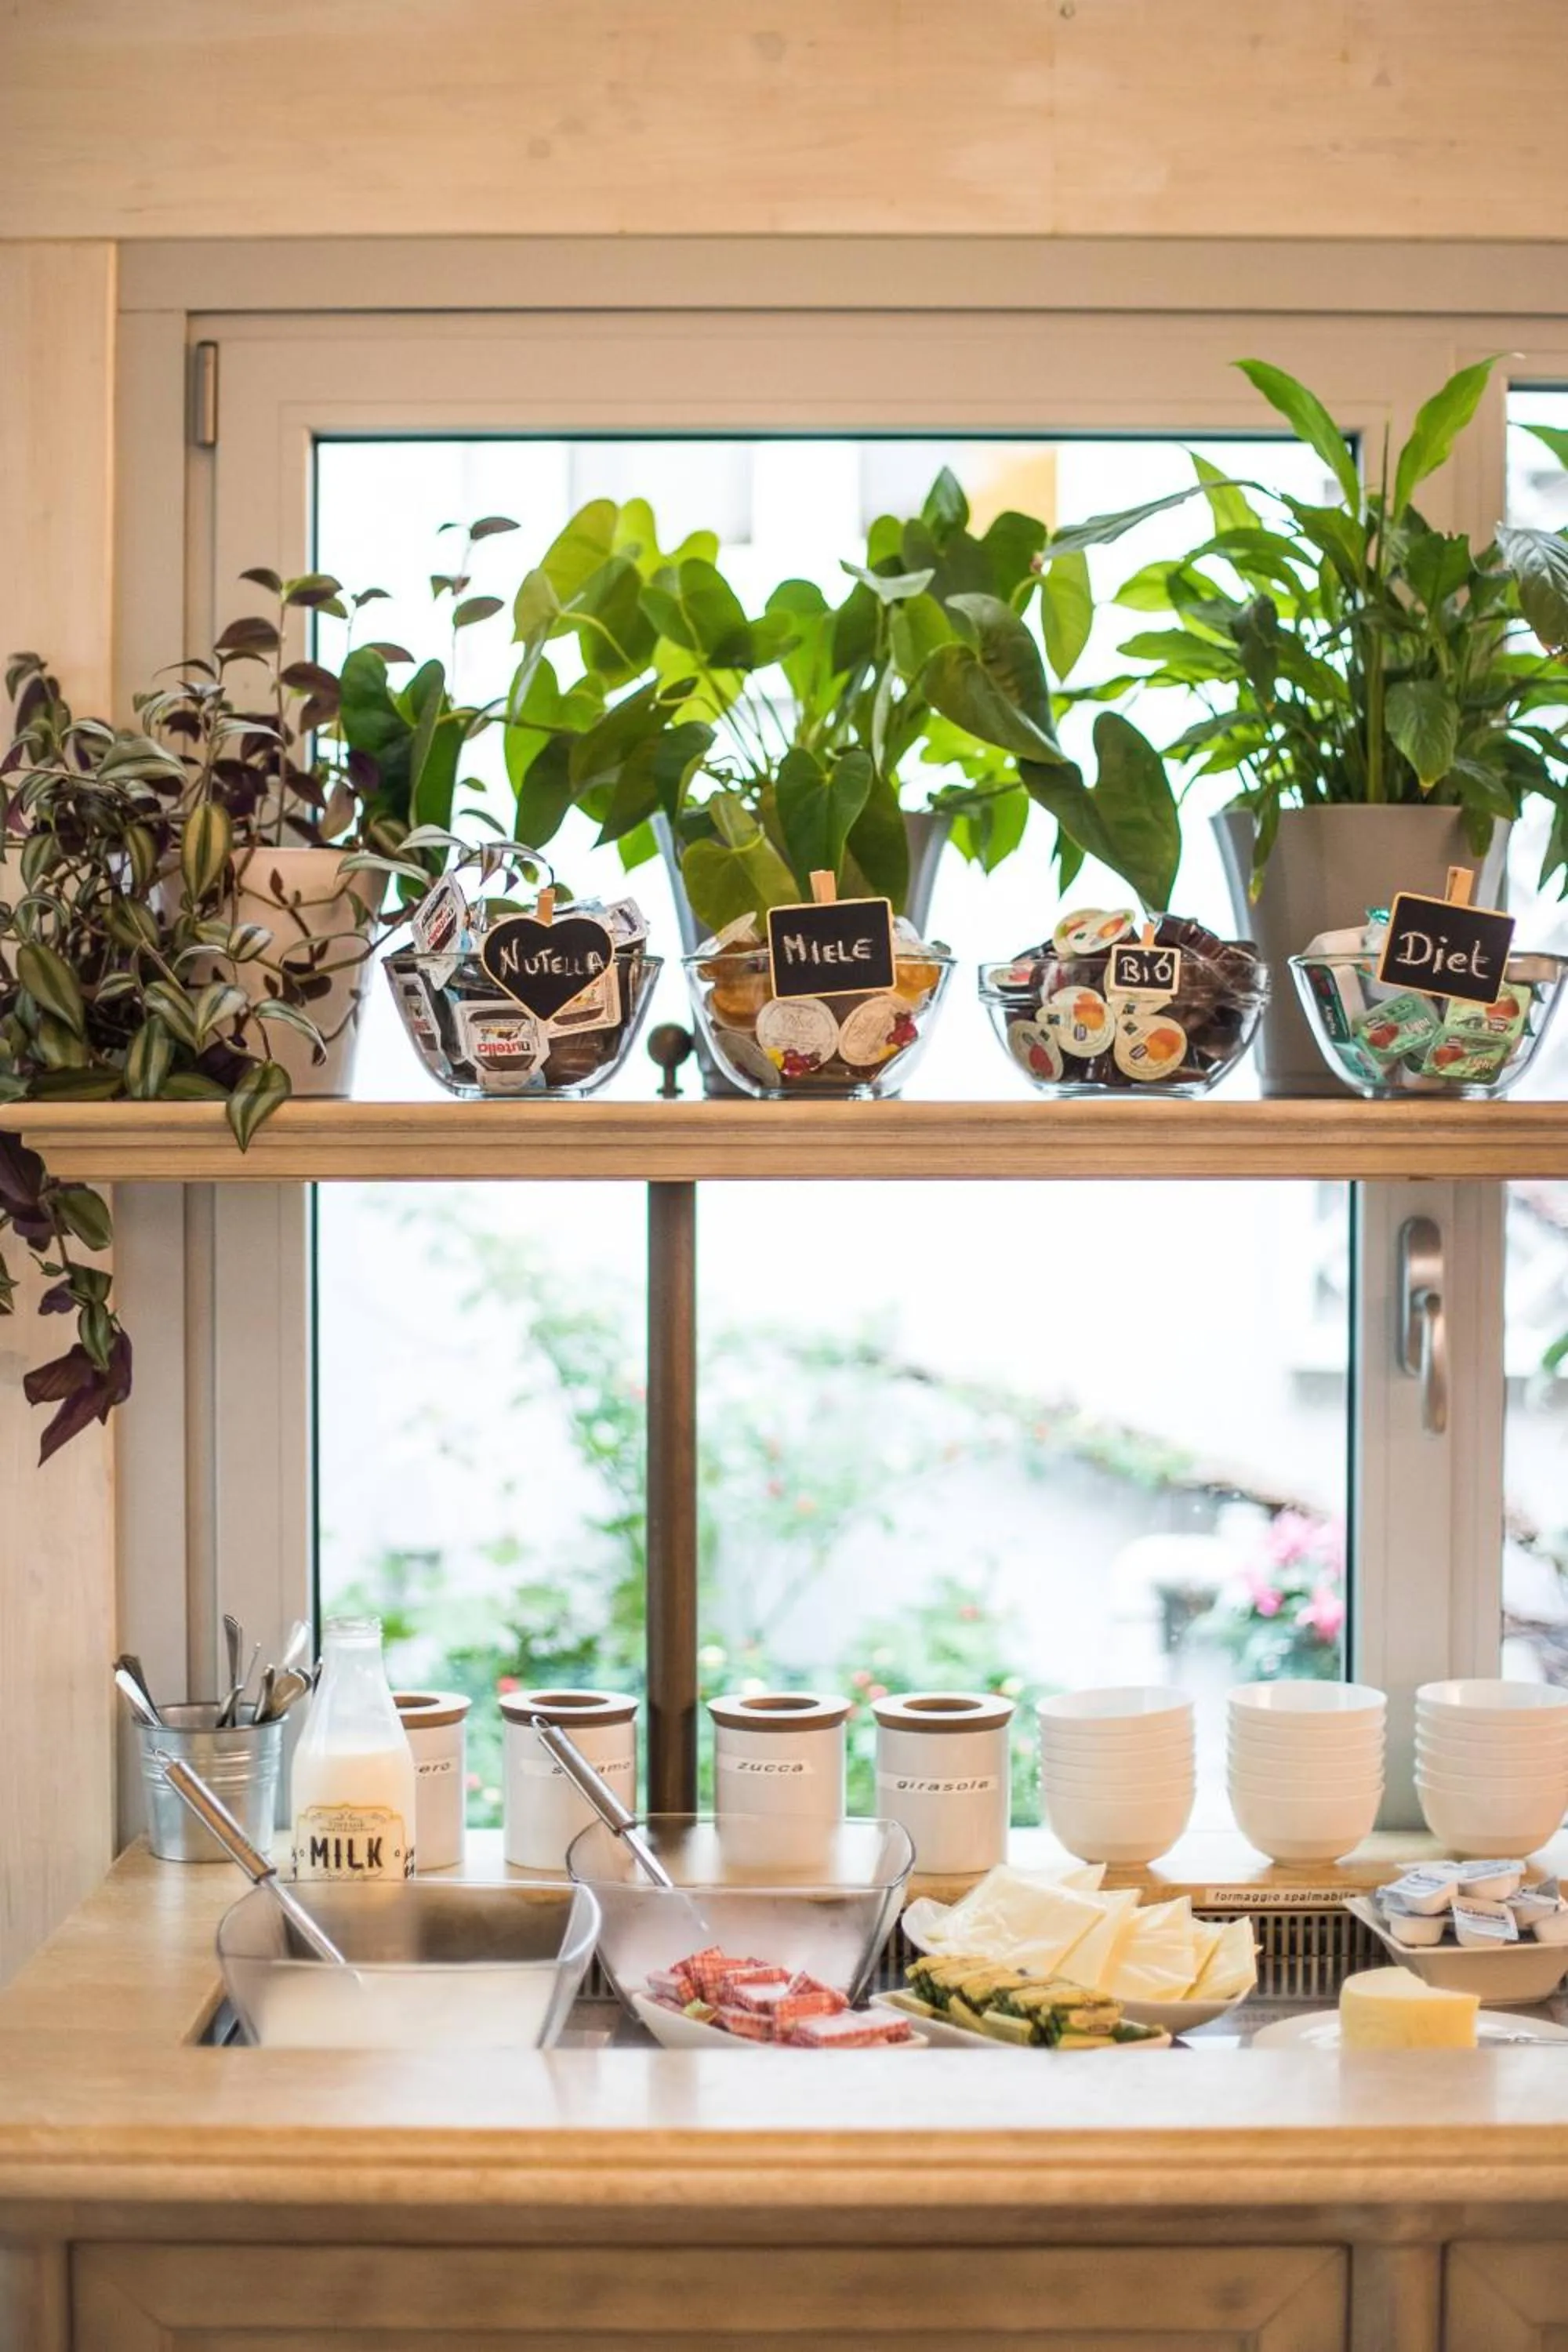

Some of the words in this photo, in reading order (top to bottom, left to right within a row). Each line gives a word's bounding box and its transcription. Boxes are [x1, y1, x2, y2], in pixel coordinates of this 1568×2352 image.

[499, 938, 605, 979] NUTELLA
[782, 932, 874, 966] MIELE
[1395, 930, 1491, 980] Diet
[477, 1040, 531, 1056] nutella
[737, 1762, 804, 1773] zucca
[896, 1780, 990, 1792] girasole
[310, 1835, 383, 1870] MILK
[1214, 1891, 1281, 1903] formaggio
